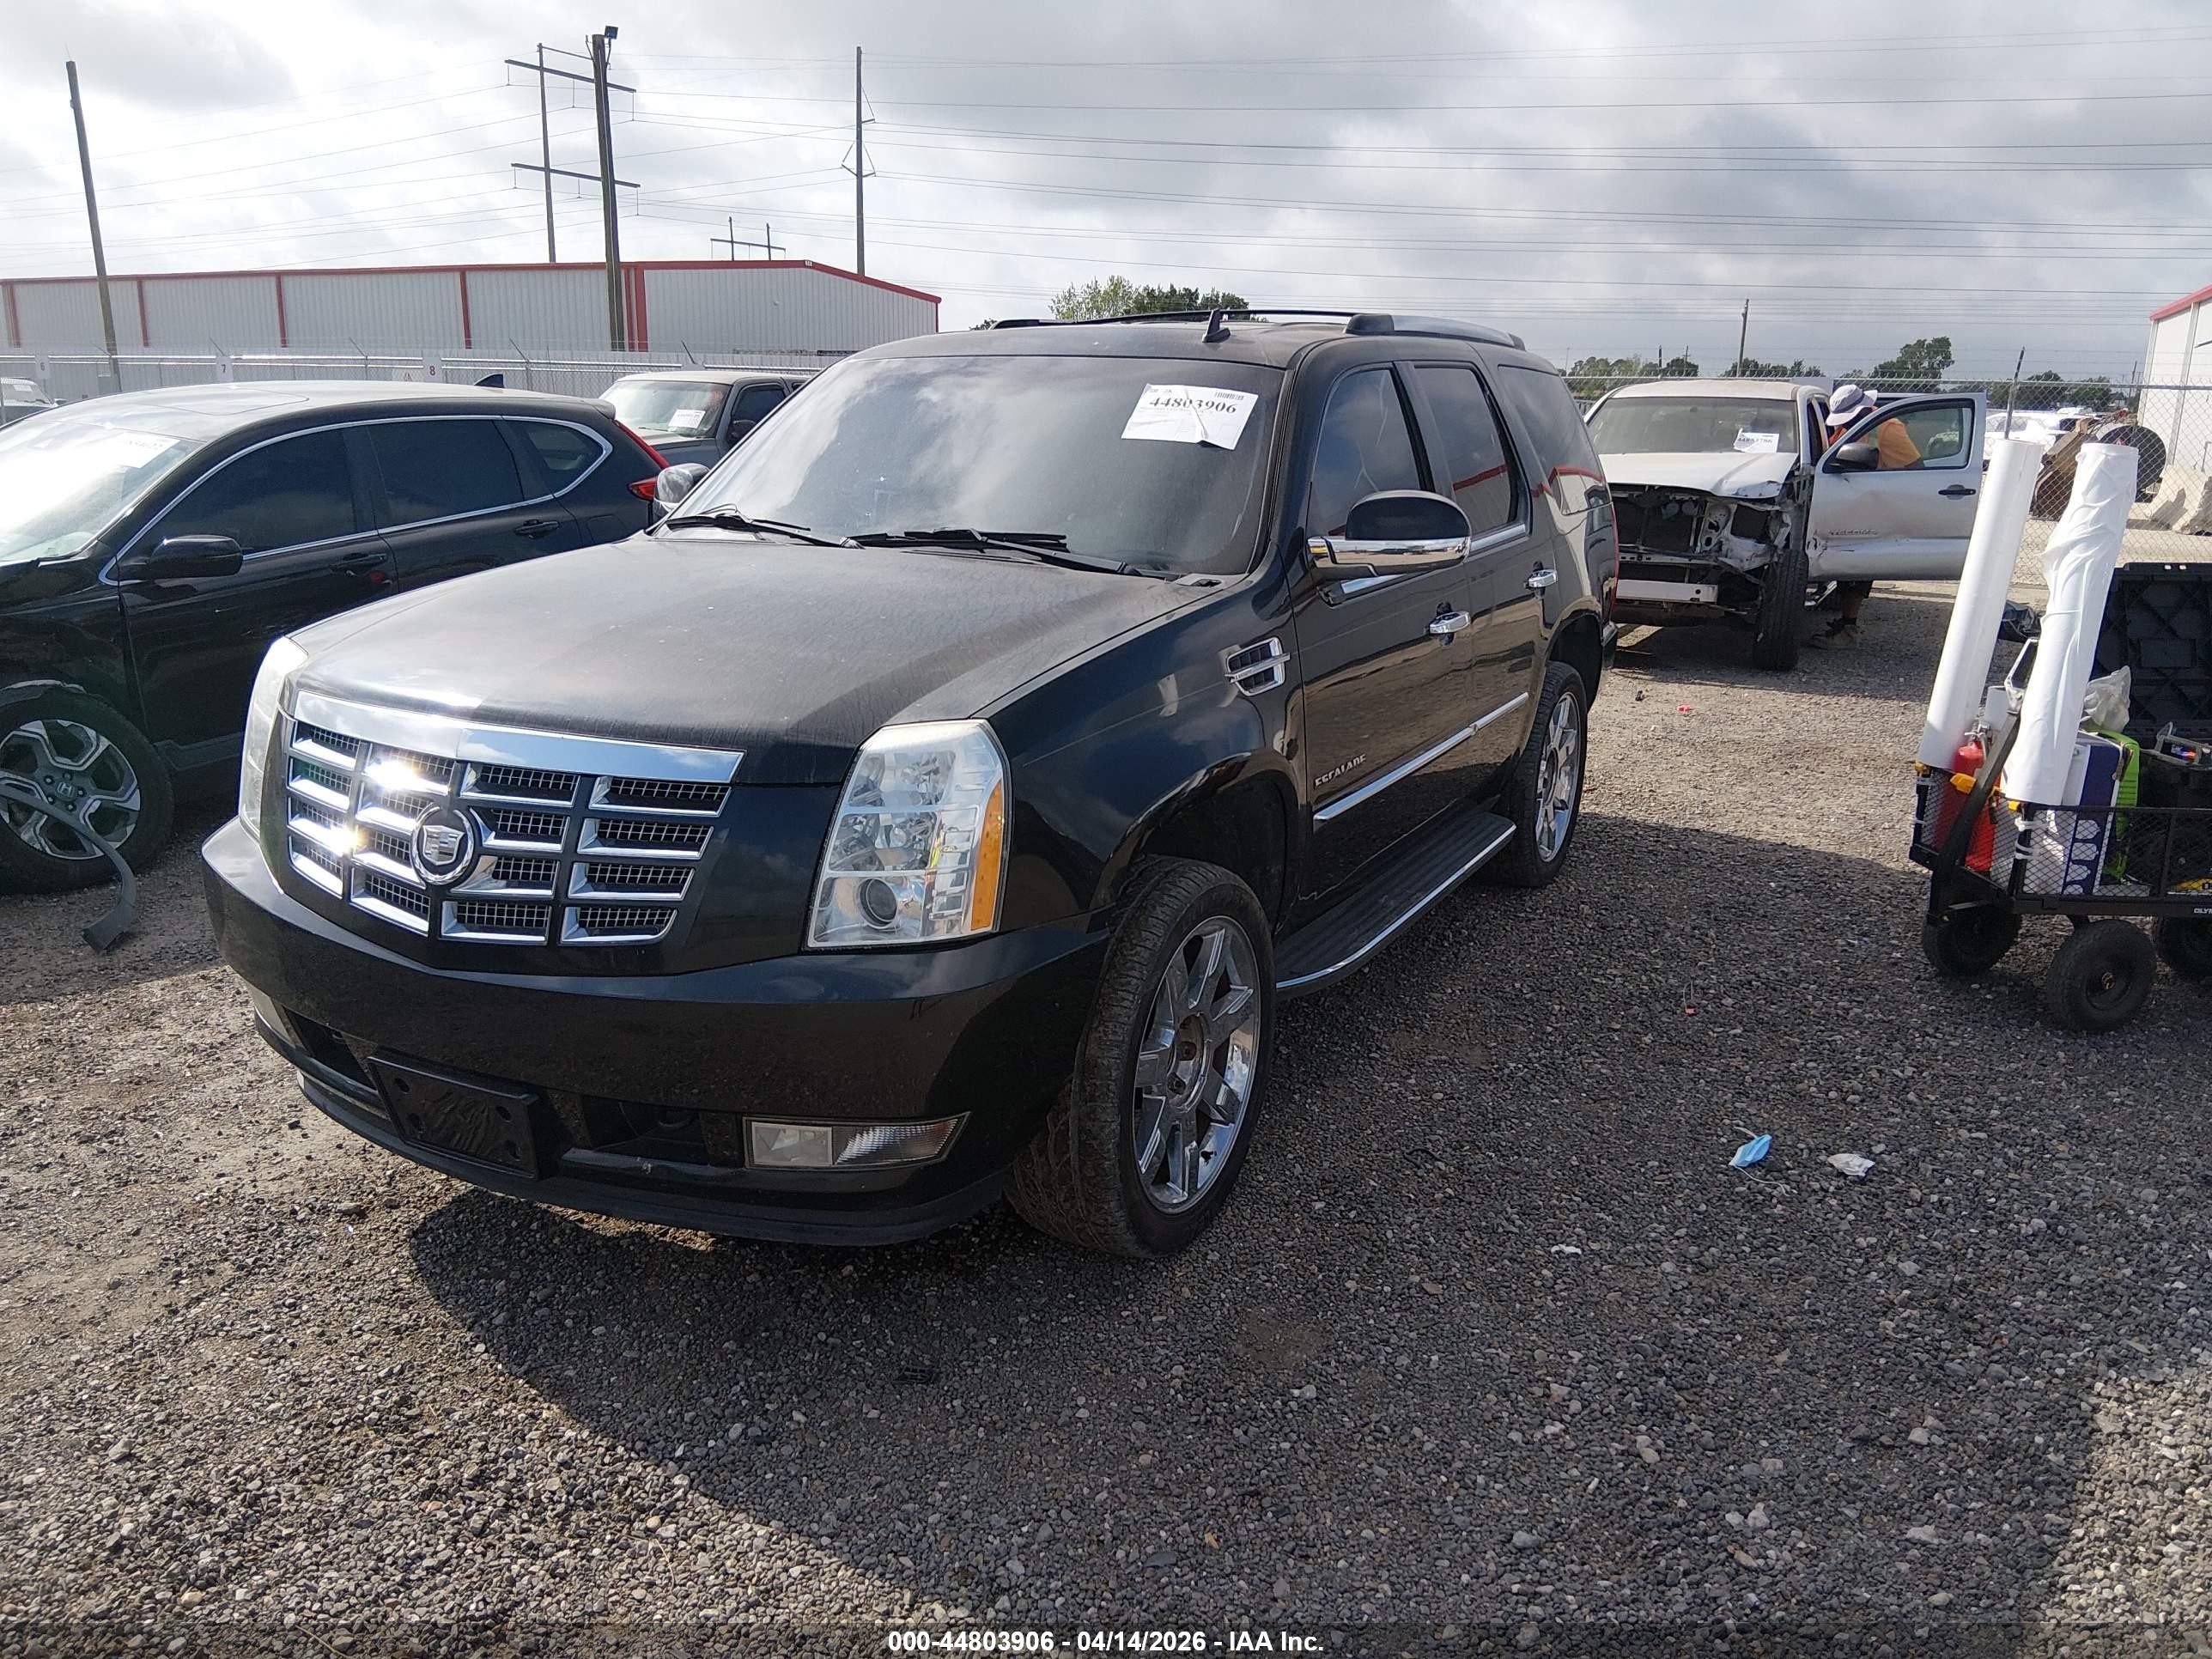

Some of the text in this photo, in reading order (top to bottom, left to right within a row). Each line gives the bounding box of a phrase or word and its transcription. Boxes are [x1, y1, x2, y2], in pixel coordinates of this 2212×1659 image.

[221, 364, 226, 373] 7
[429, 365, 436, 375] 8
[1149, 397, 1237, 414] 44803906
